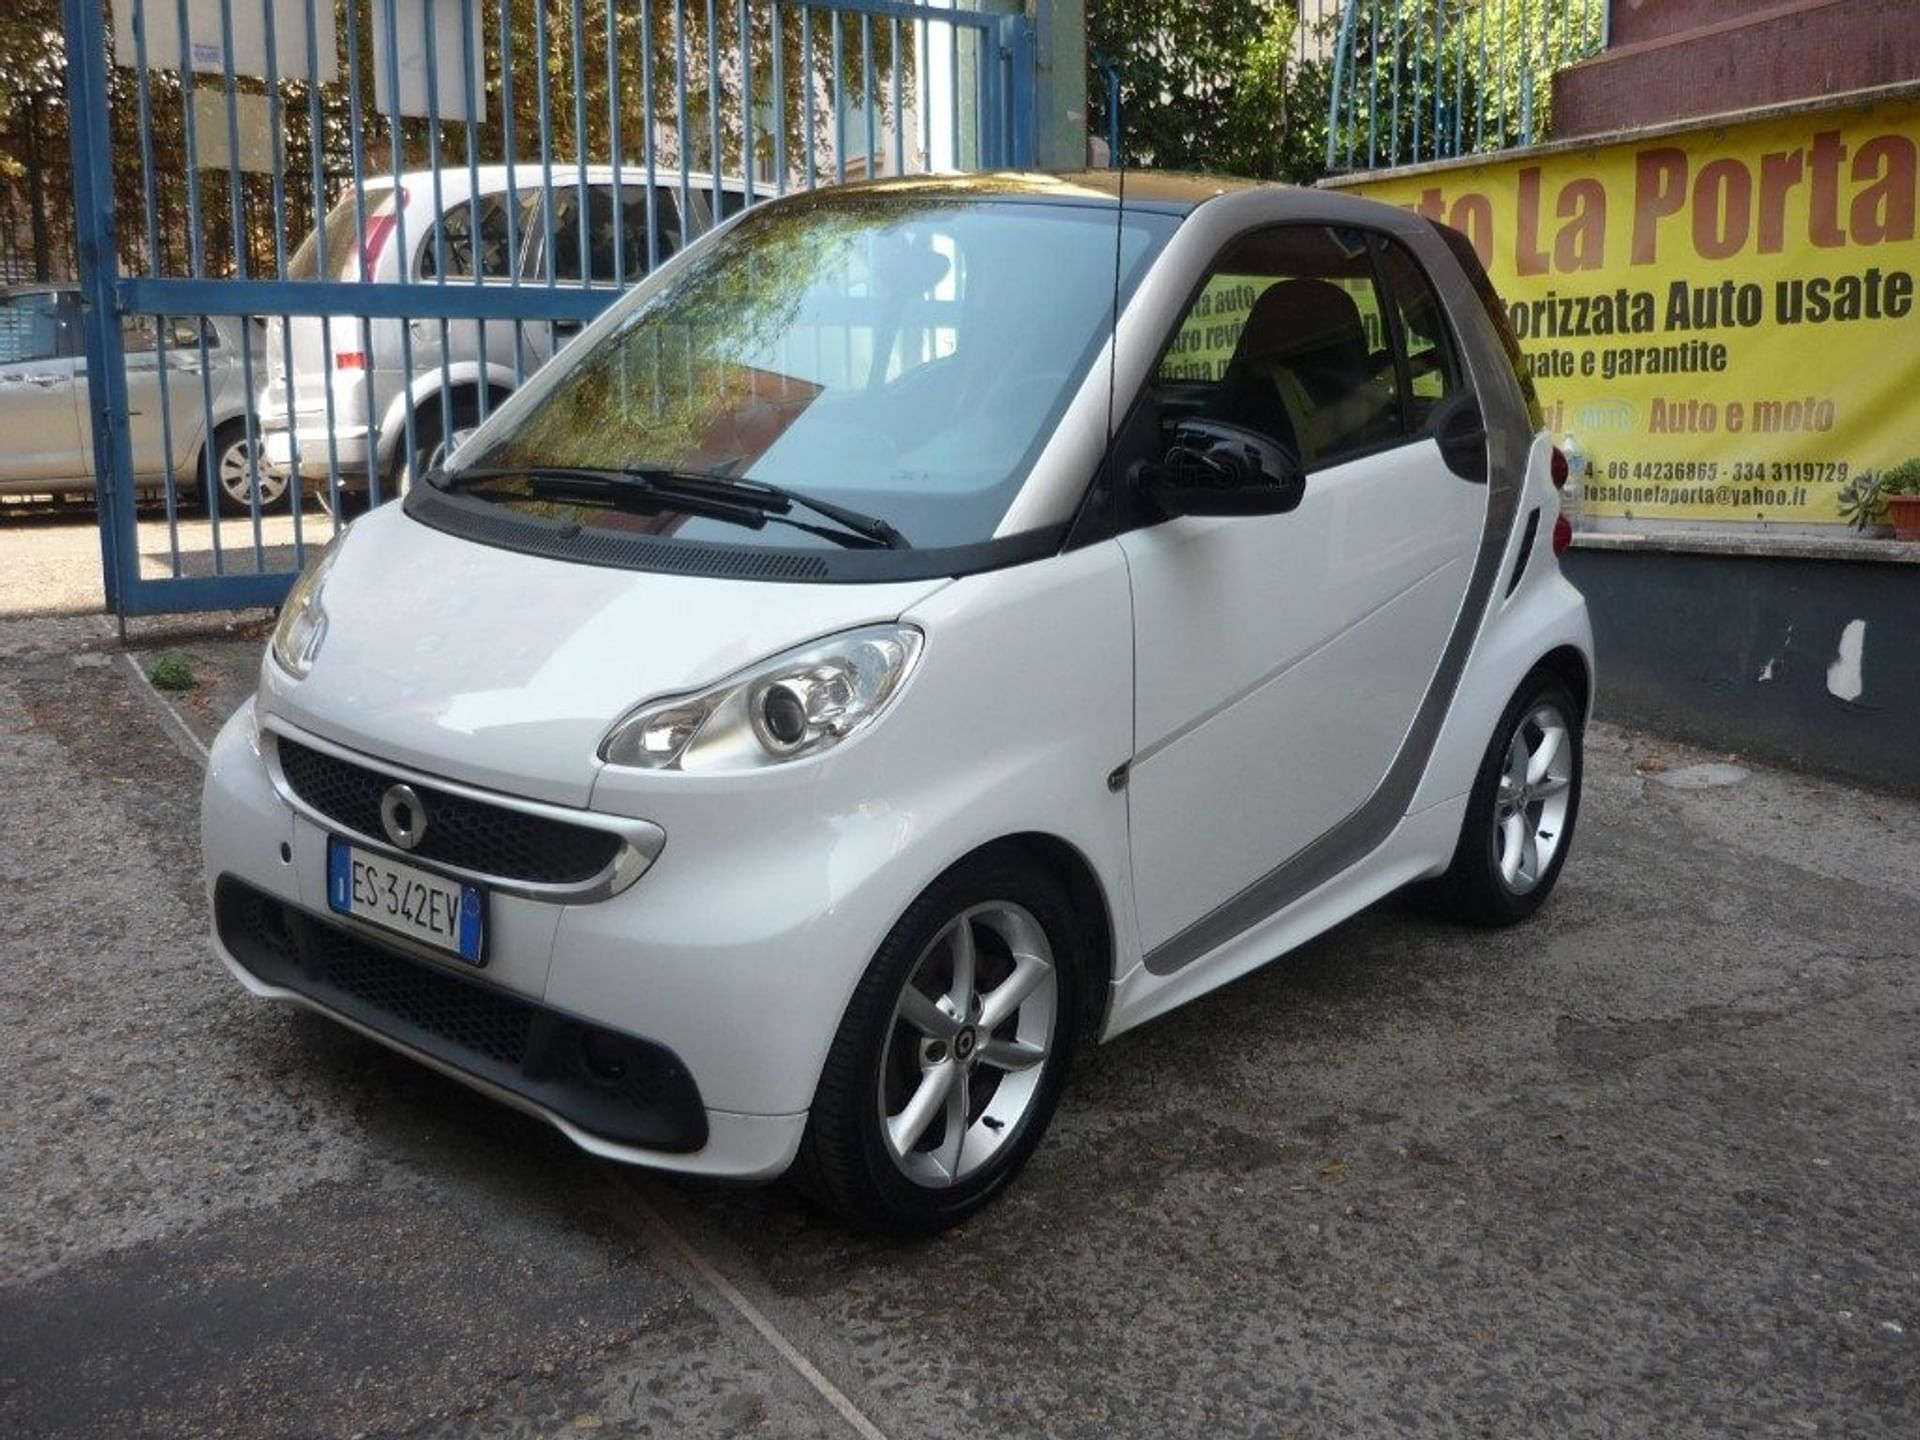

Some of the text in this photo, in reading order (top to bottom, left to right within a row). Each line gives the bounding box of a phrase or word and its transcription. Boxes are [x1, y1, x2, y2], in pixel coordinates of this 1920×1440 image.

[1516, 166, 1607, 276] La
[1631, 130, 1917, 265] Porta
[1664, 280, 1762, 331] Auto
[1776, 268, 1914, 325] usate
[1581, 350, 1595, 376] e
[1602, 339, 1727, 379] garantite
[1649, 398, 1717, 433] Auto
[1726, 401, 1744, 432] e
[1752, 397, 1835, 432] moto
[1608, 461, 1628, 480] 06
[1633, 461, 1717, 482] 44236865
[1732, 462, 1765, 482] 334
[1772, 462, 1848, 483] 3119729
